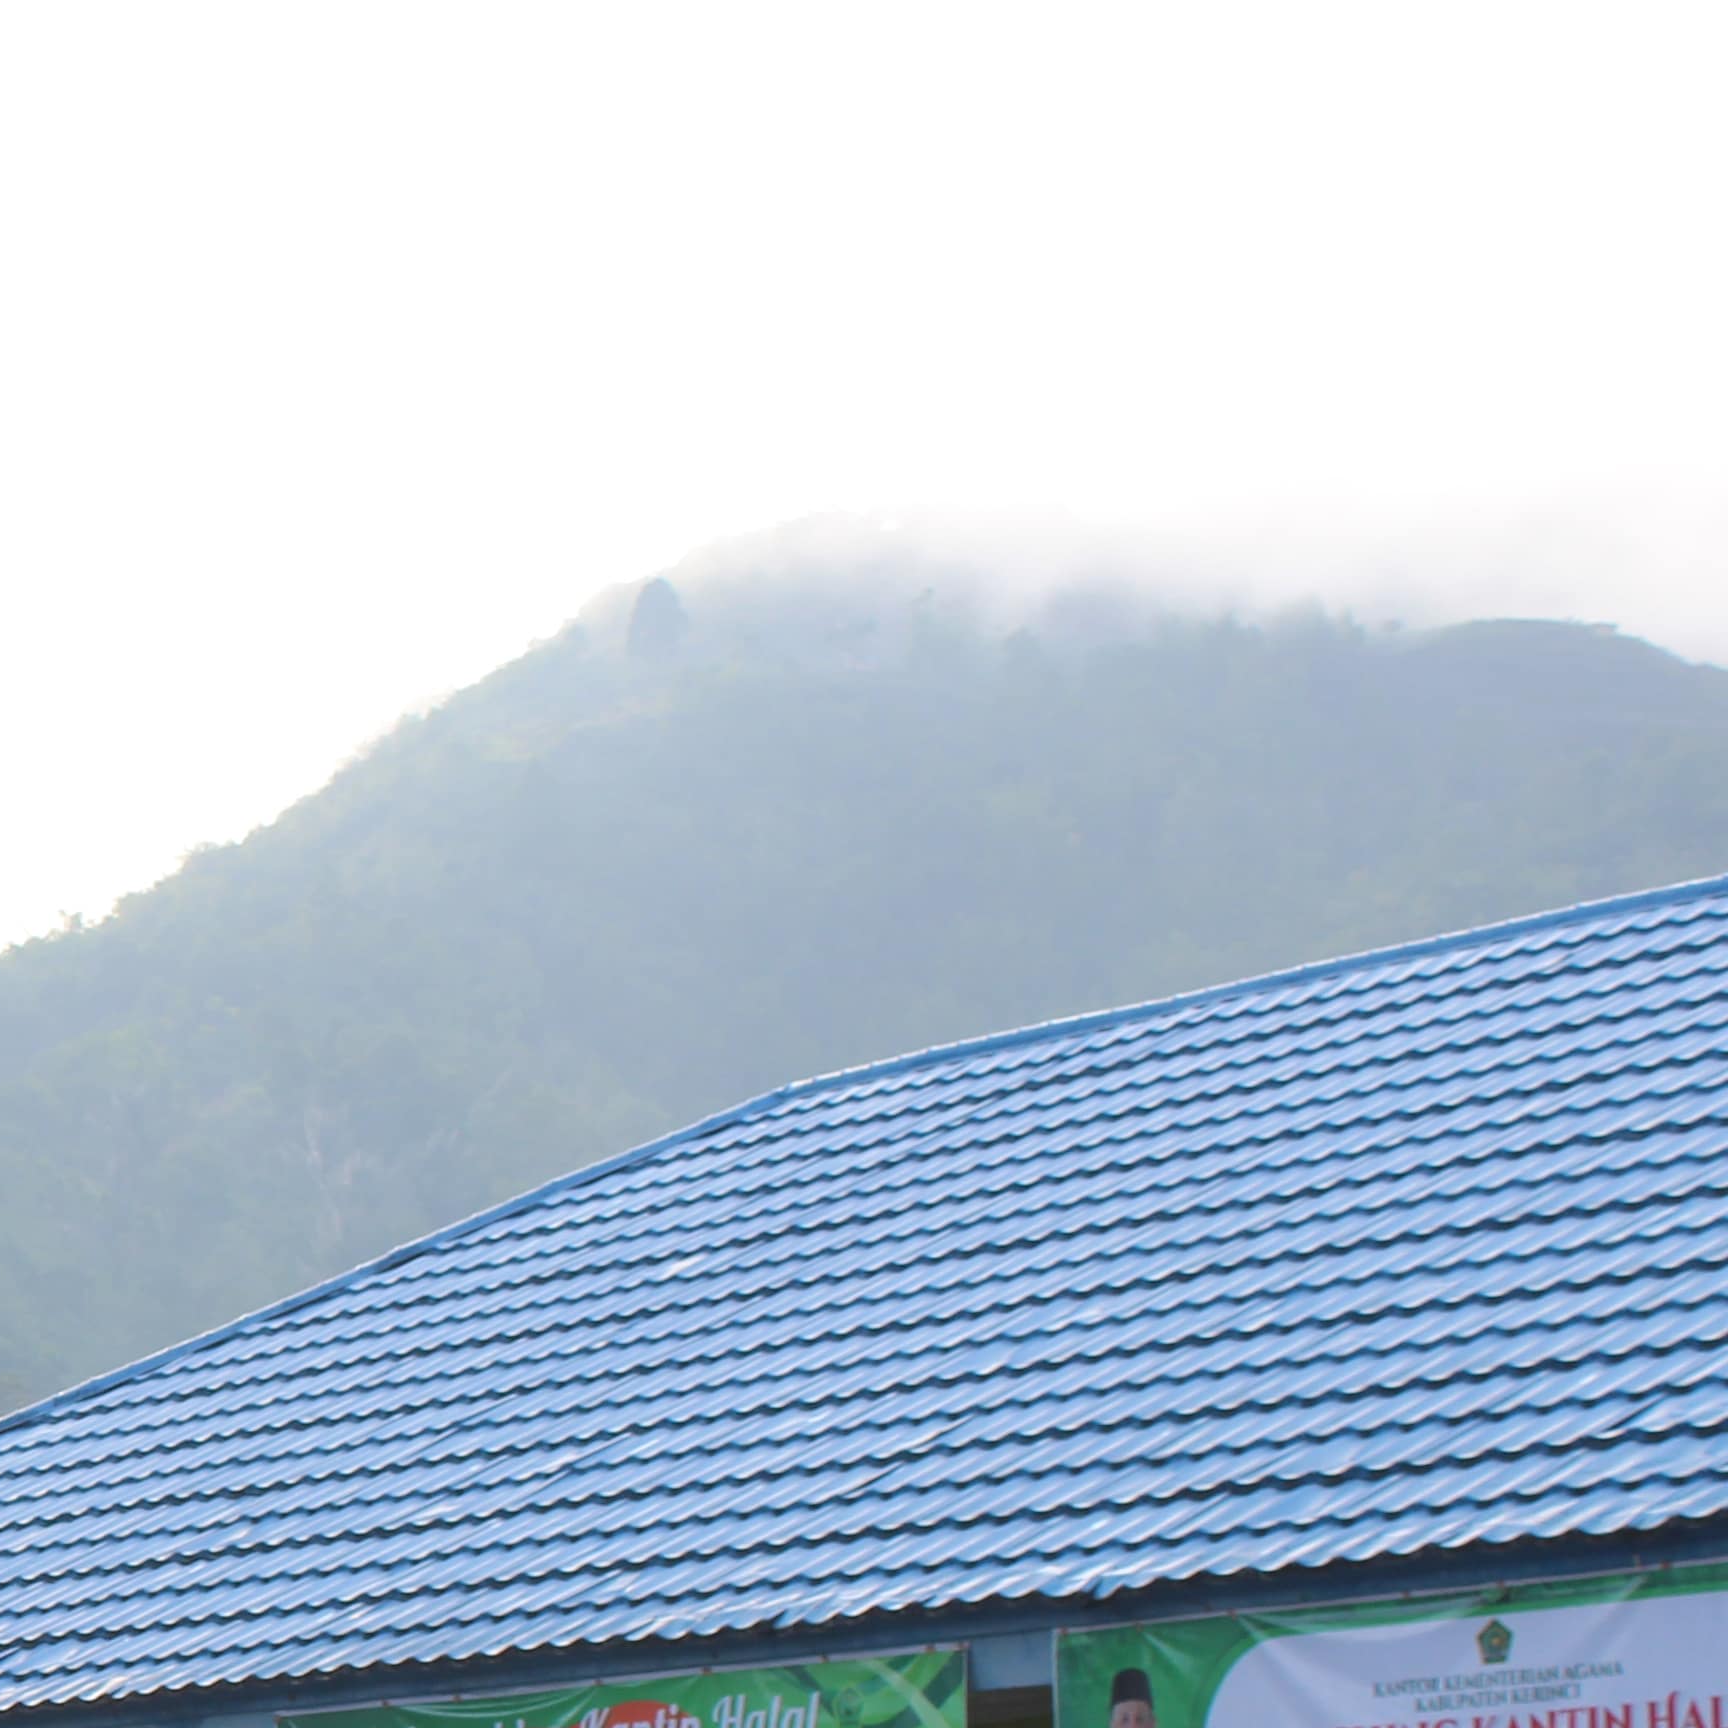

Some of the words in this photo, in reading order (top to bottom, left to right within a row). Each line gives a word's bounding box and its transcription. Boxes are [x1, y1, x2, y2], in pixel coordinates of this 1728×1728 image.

[1373, 1677, 1440, 1697] KANTOR
[1445, 1666, 1559, 1691] KEMENTERIAN
[1563, 1662, 1624, 1680] AGAMA
[1415, 1691, 1508, 1712] KABUPATEN
[1511, 1683, 1581, 1704] KERINCI
